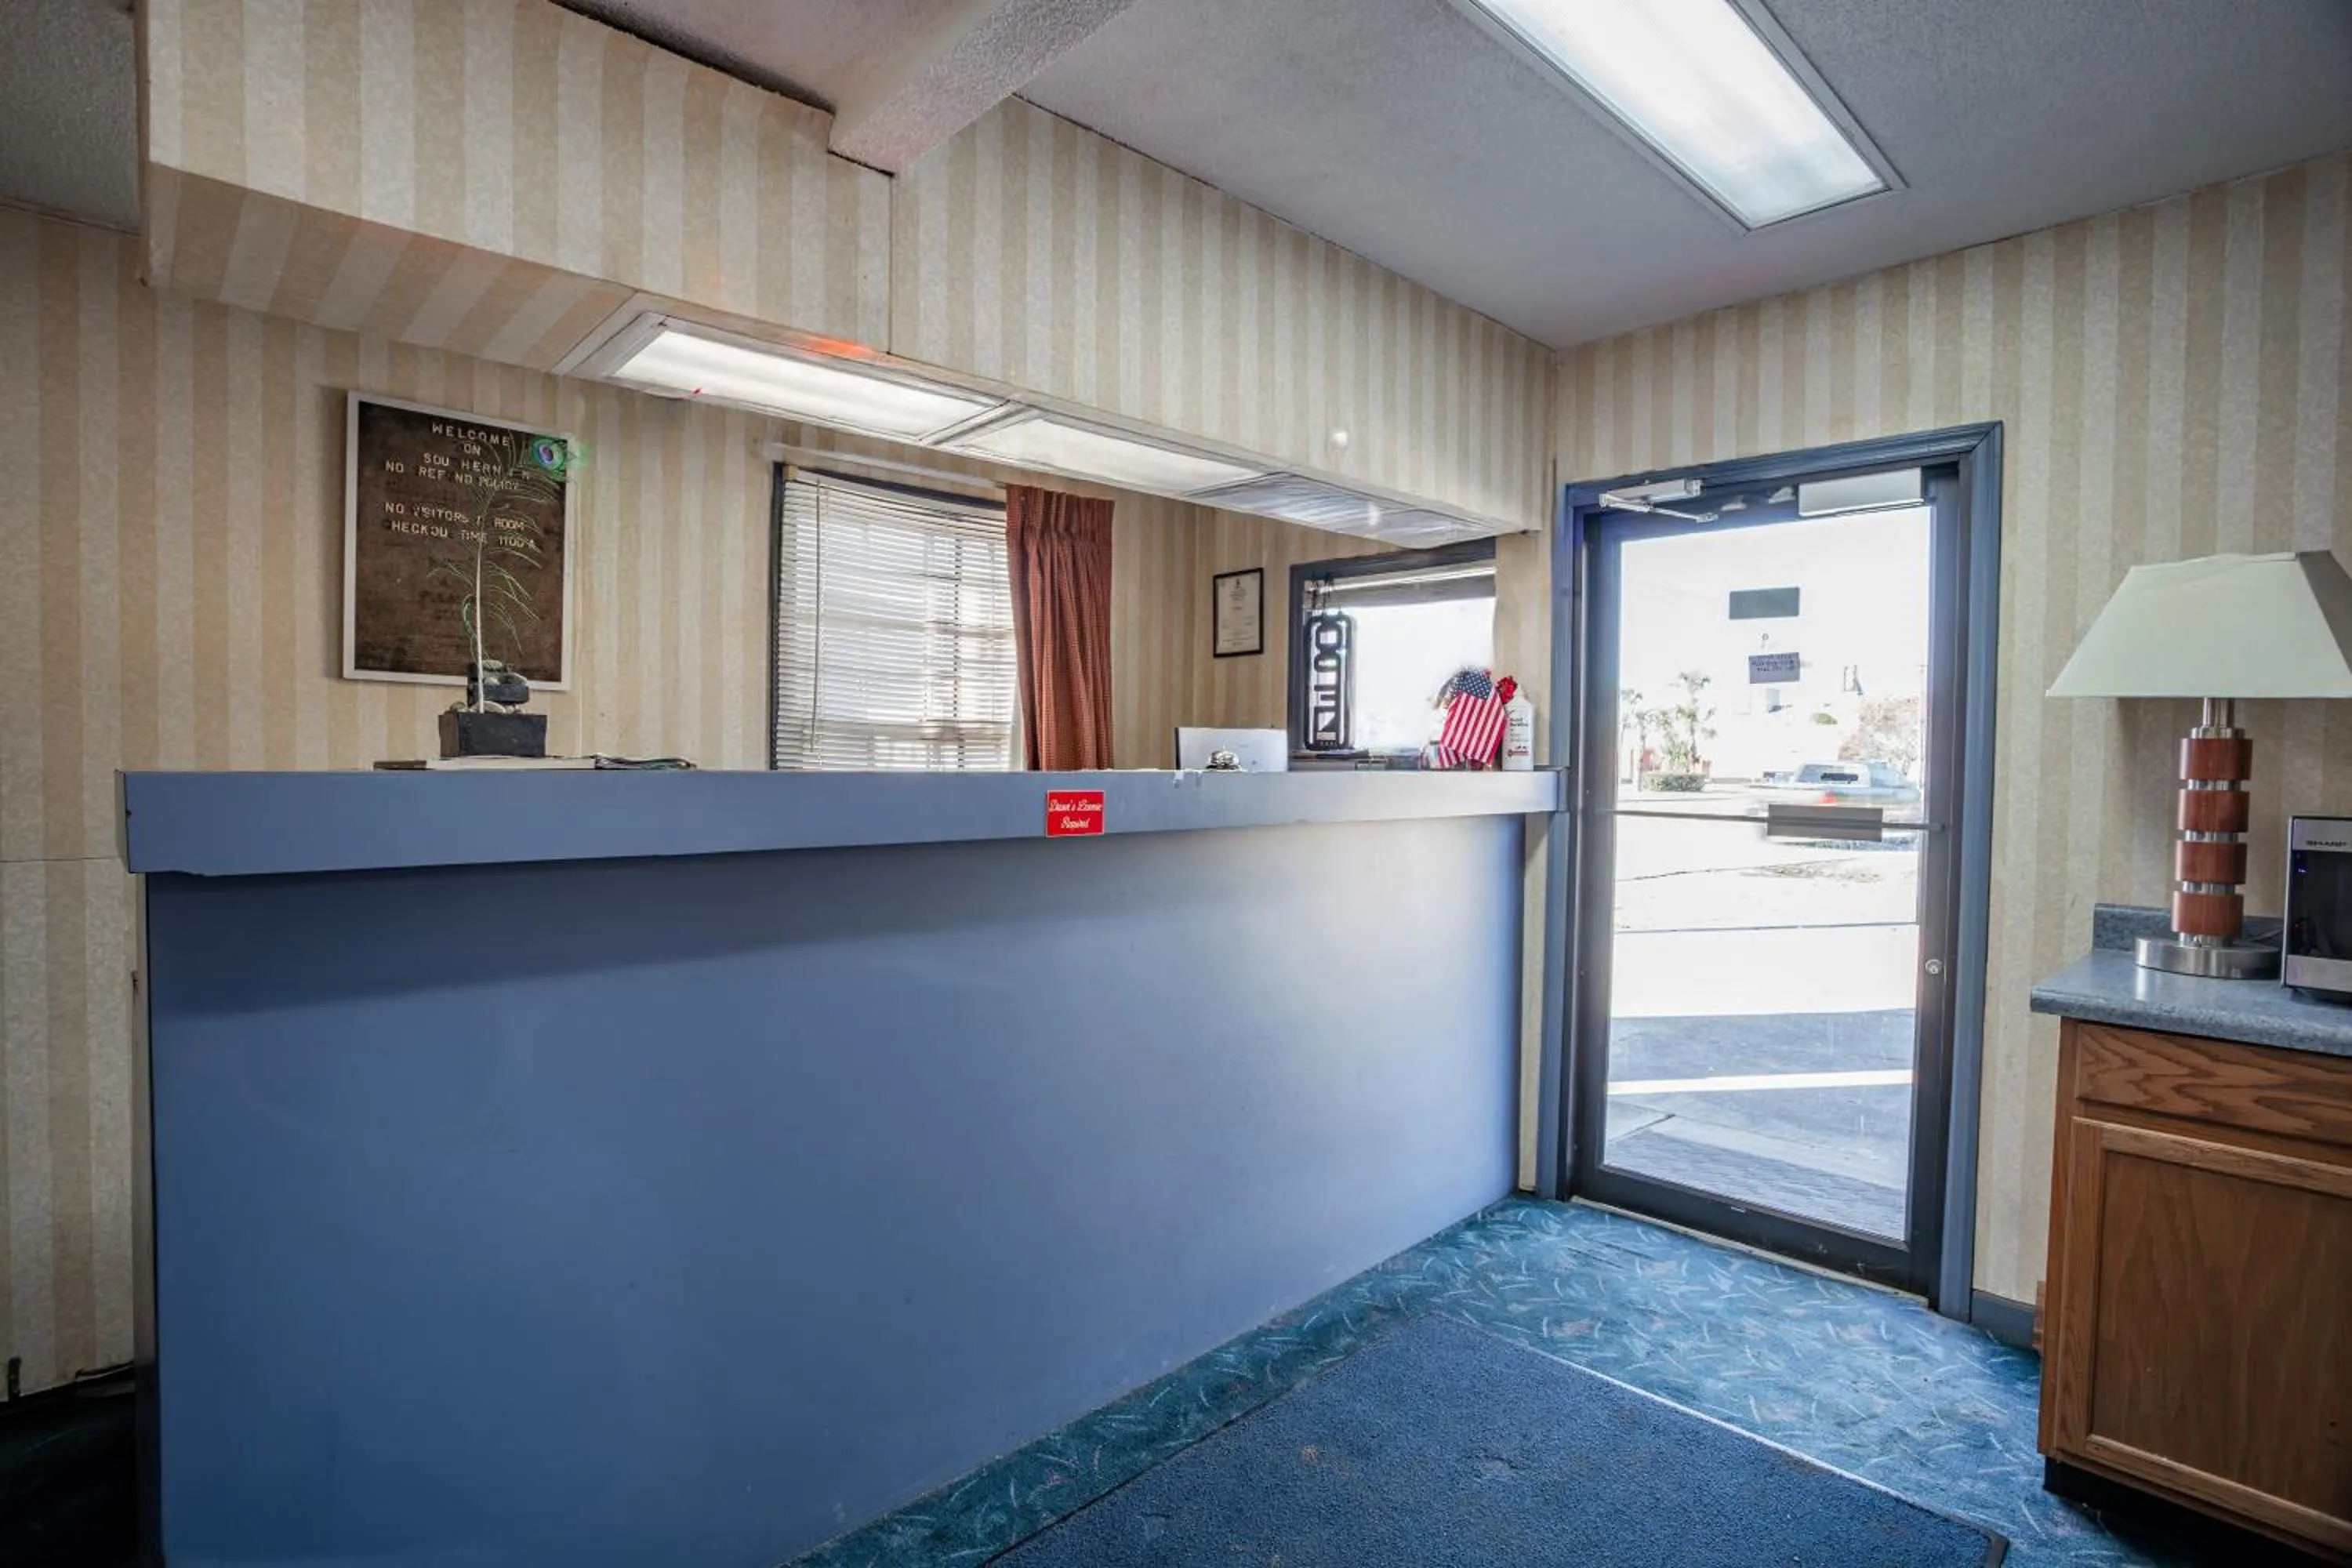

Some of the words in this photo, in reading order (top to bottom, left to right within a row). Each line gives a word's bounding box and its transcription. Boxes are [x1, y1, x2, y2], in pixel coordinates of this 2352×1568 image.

[432, 422, 510, 446] WELCOME
[385, 459, 404, 473] NO
[385, 502, 405, 514] NO
